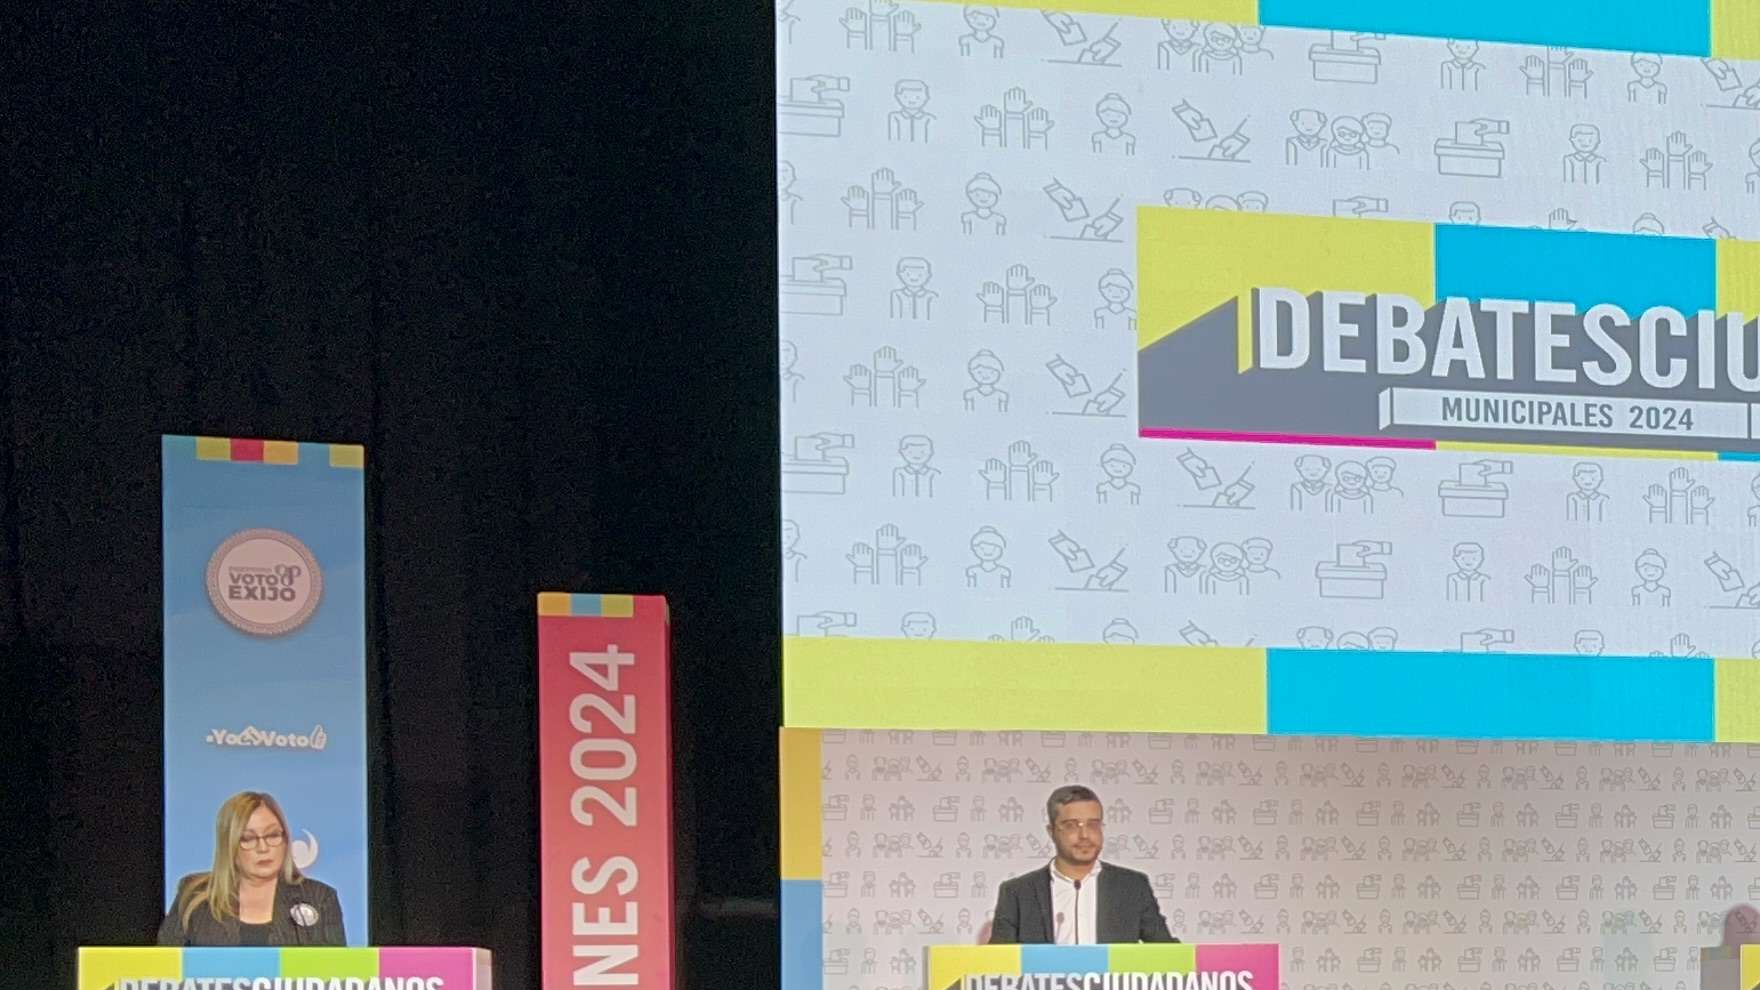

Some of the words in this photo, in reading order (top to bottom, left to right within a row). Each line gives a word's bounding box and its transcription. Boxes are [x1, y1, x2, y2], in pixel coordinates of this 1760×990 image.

[1441, 396, 1614, 429] MUNICIPALES
[1629, 404, 1695, 432] 2024
[229, 572, 278, 586] VOTO
[228, 585, 296, 602] EXIJO
[569, 643, 638, 827] 2024
